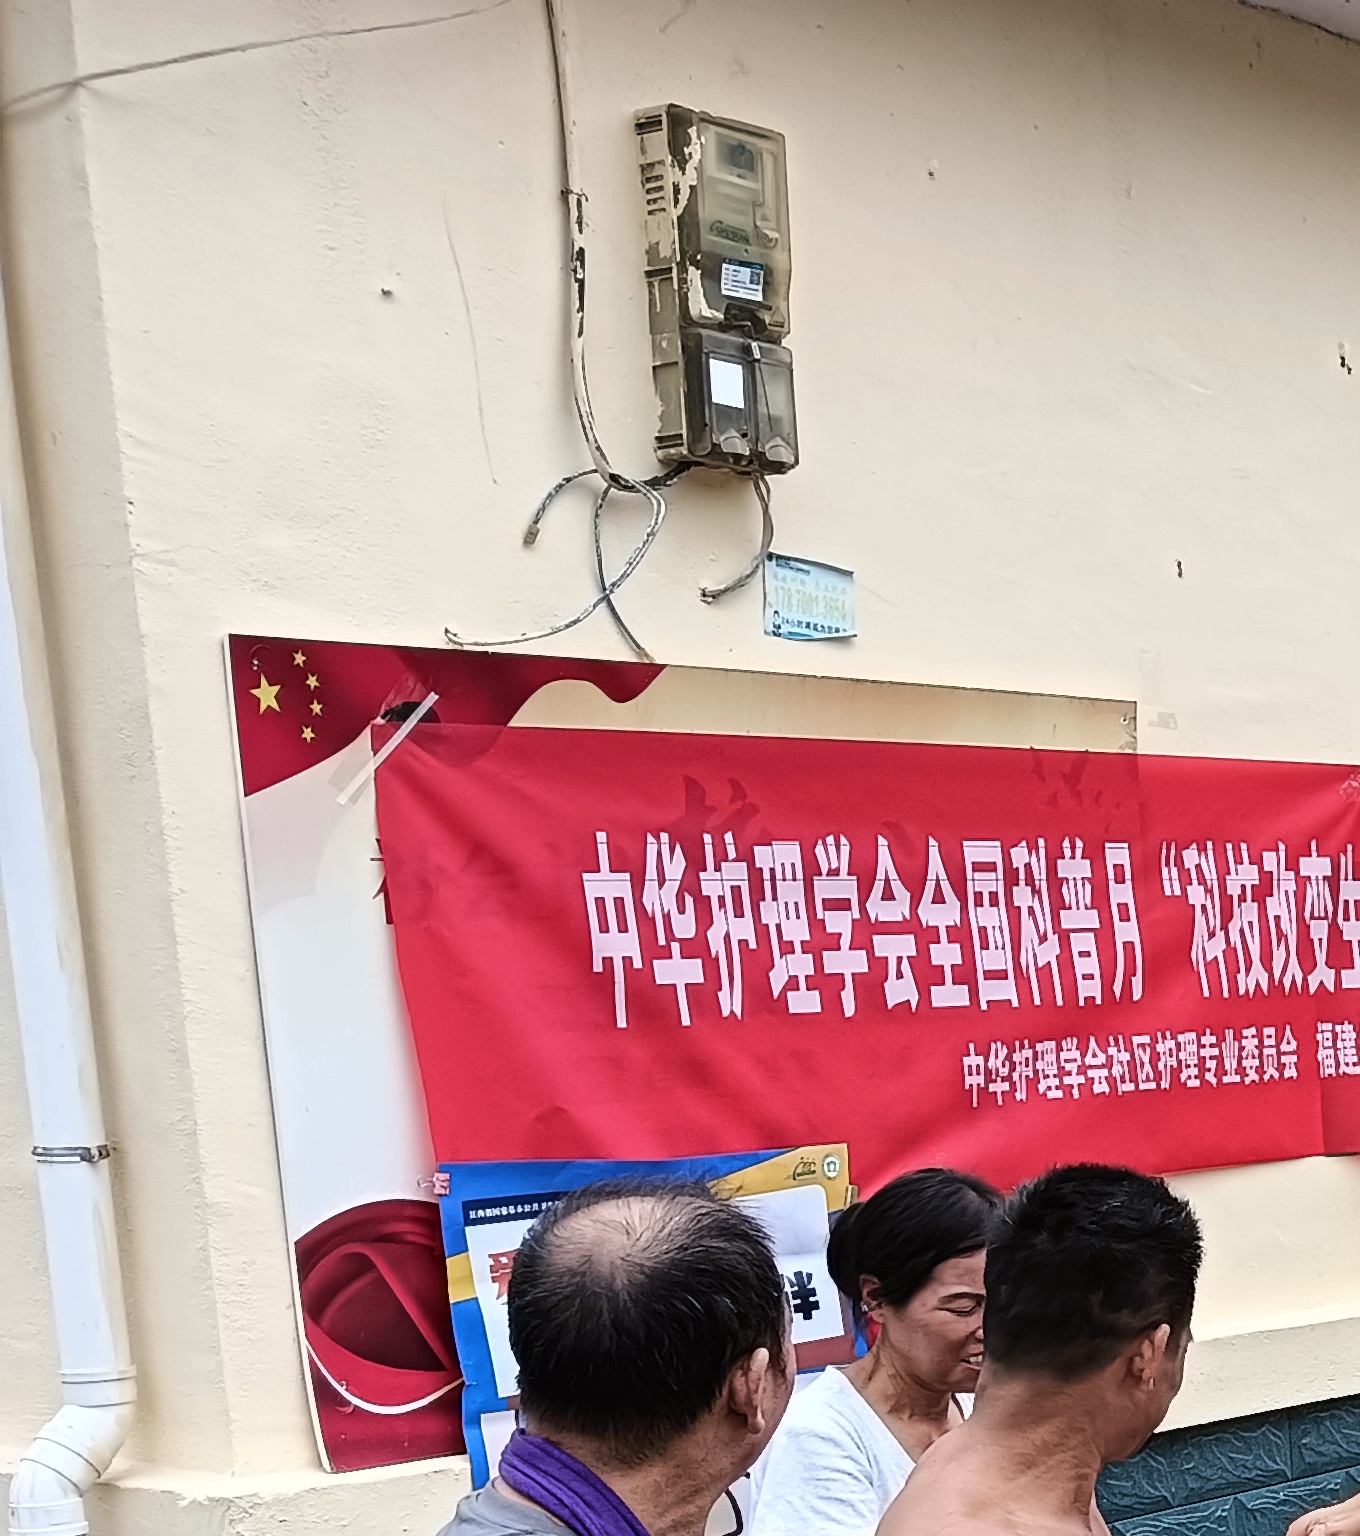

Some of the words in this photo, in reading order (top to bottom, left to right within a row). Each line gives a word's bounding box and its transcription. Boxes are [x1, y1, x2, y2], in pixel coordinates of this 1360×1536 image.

[582, 831, 1144, 1028] 中华护理学会全国科普月
[963, 1024, 1298, 1108] 中华护理学会社区护理专业委员会
